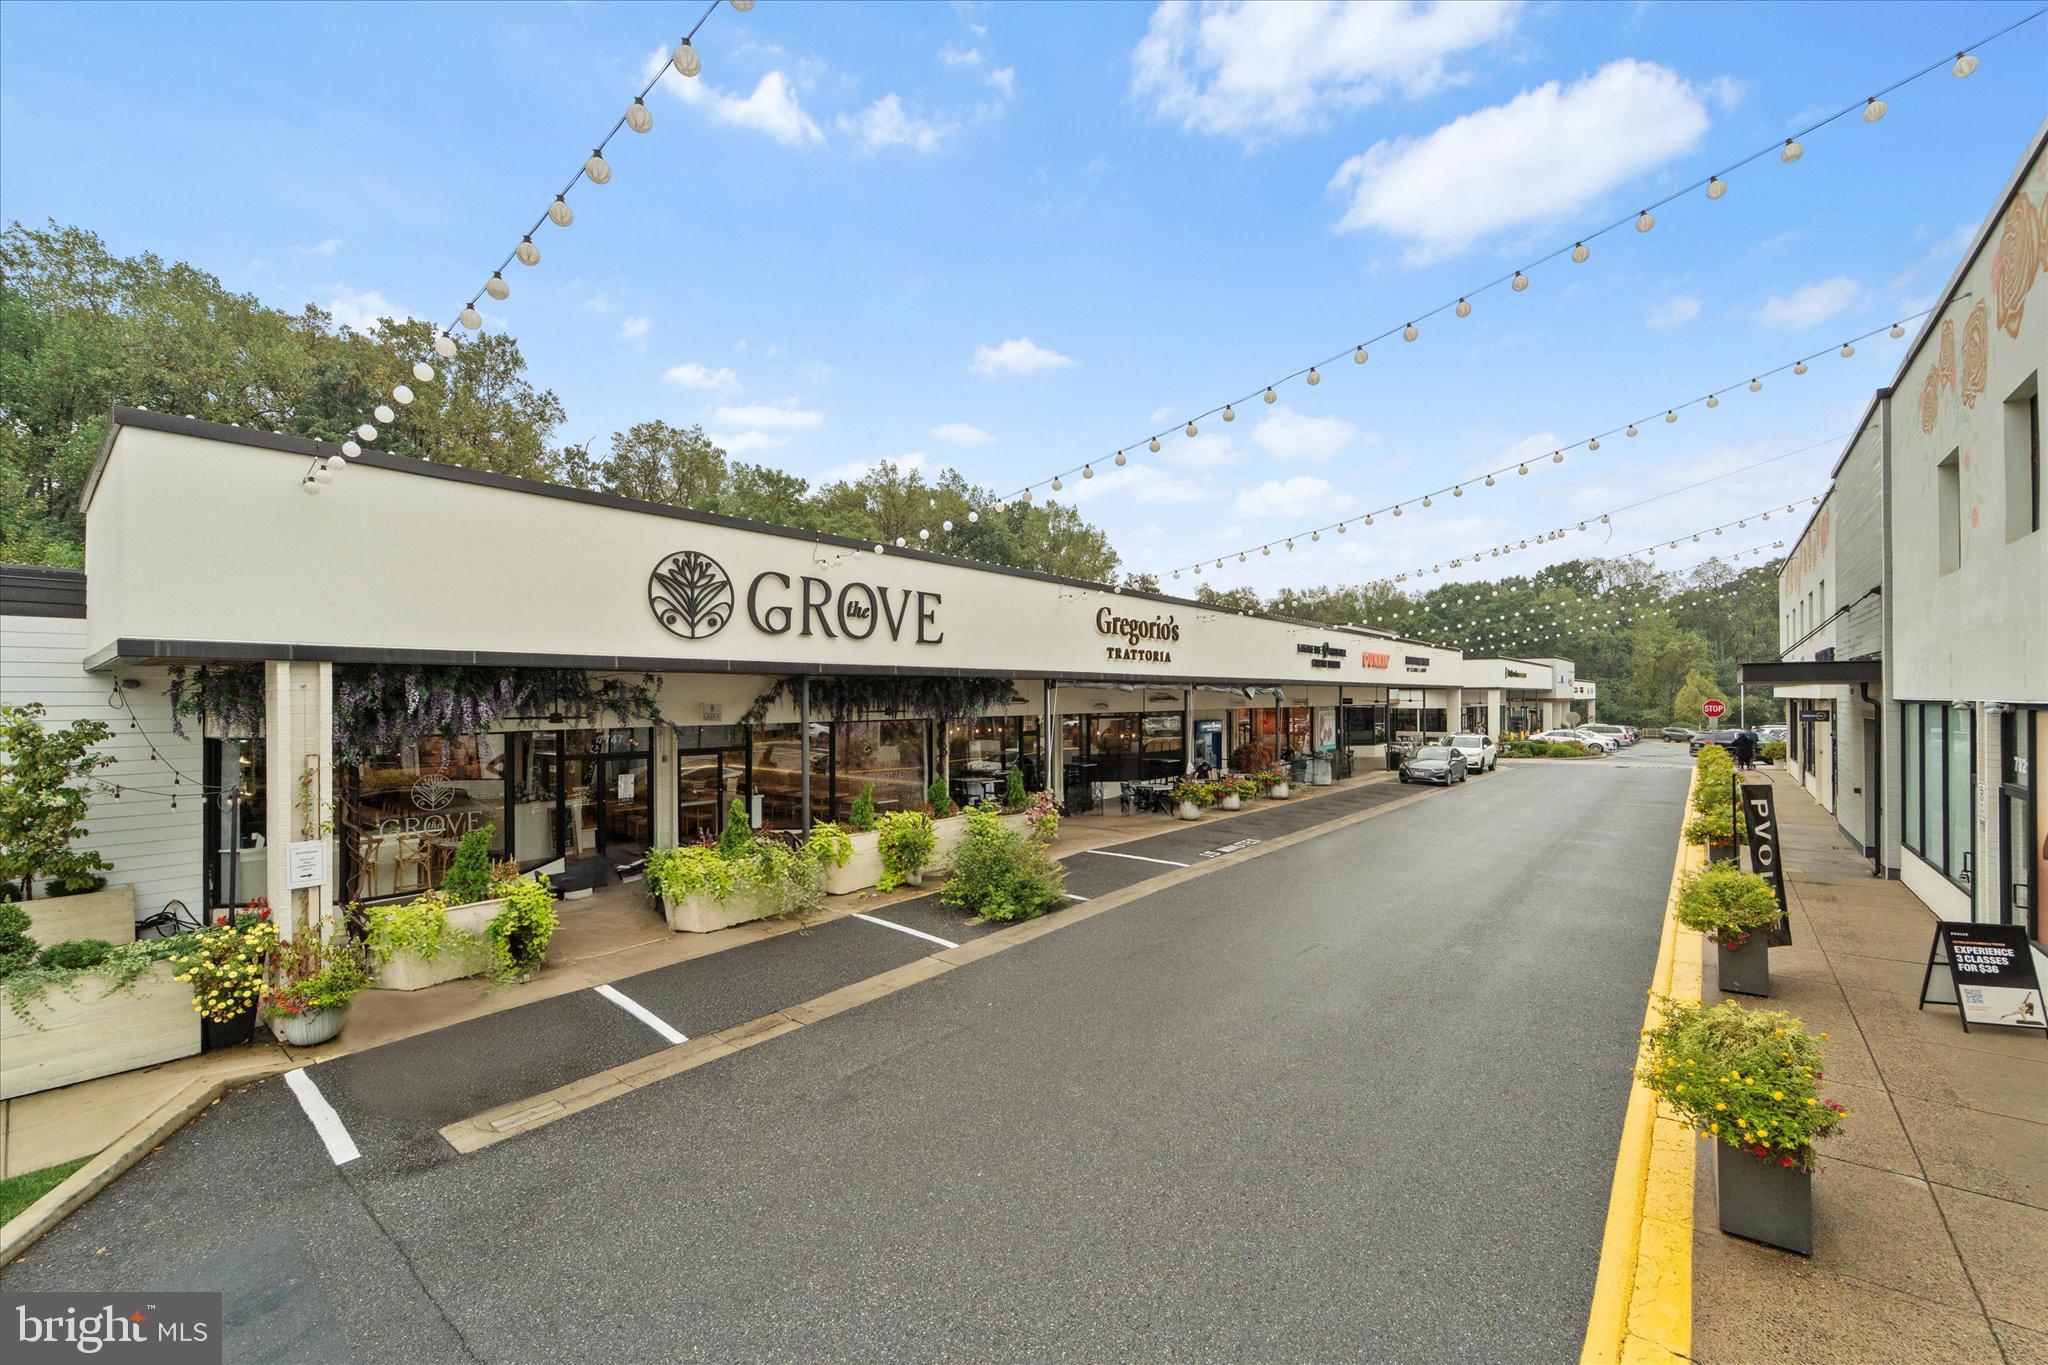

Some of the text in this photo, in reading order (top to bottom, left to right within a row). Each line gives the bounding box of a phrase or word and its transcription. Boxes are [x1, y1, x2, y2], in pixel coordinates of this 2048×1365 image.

[747, 571, 944, 644] the GROVE
[1096, 606, 1180, 646] Gregorio's
[1106, 647, 1172, 662] TRATTORIA
[1703, 704, 1724, 713] STOP
[1953, 945, 2015, 957] EXPERIENCE
[1955, 954, 2010, 966] 3 CLASSES
[1958, 963, 2000, 974] FOR $36
